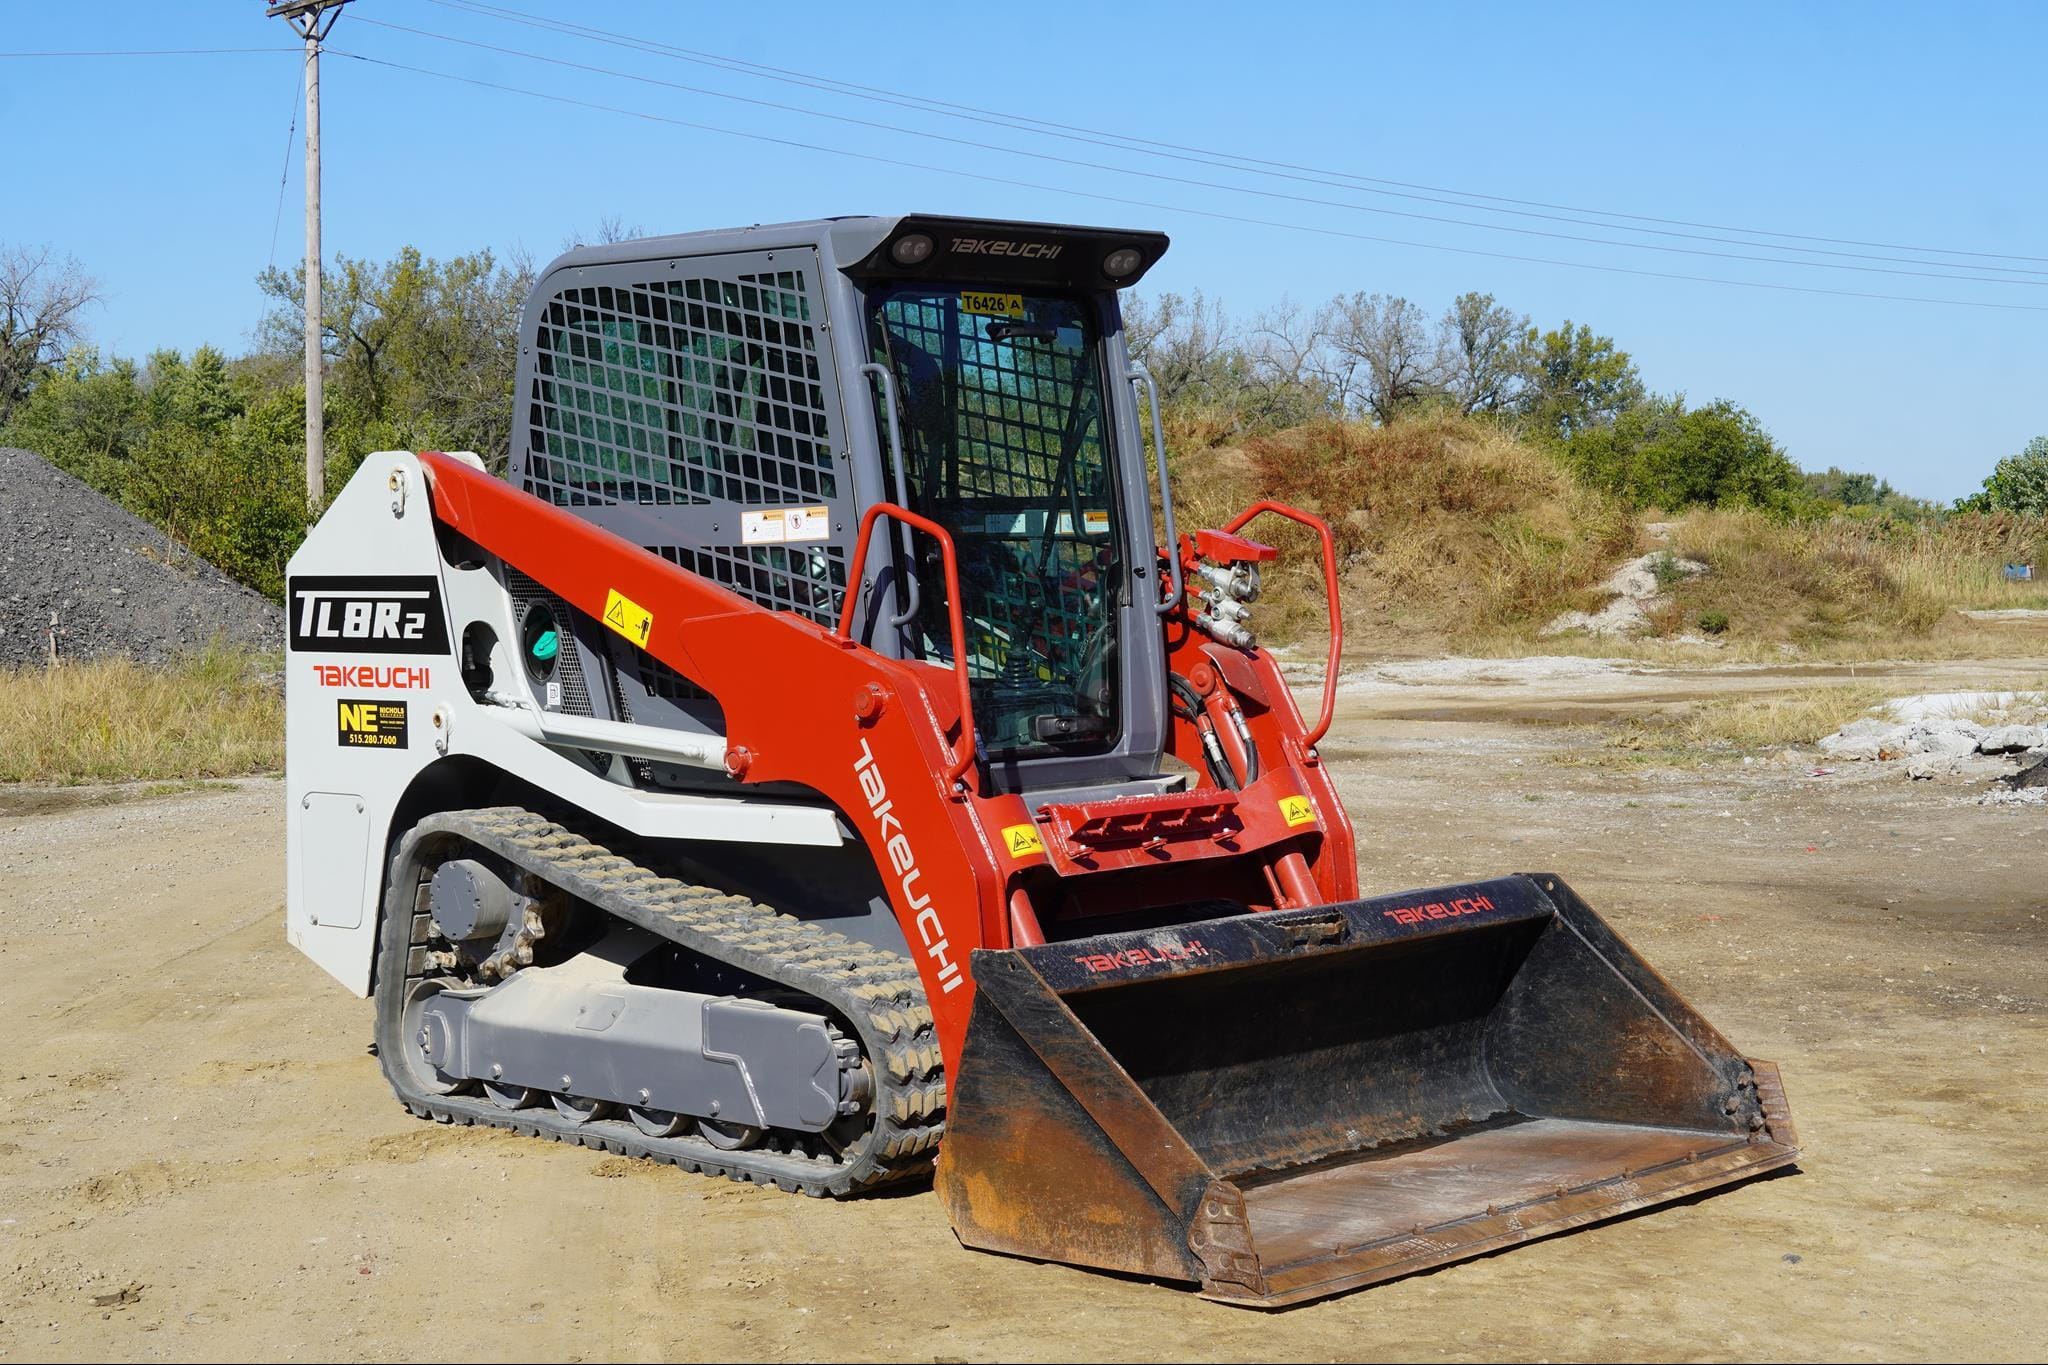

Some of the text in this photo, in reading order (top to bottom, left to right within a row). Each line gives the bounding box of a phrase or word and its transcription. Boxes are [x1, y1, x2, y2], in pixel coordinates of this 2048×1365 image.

[950, 238, 1063, 259] TAKEUCHI
[964, 295, 1020, 312] T6426 A
[295, 590, 430, 639] TL8R2
[313, 665, 430, 689] TAKEUCHI
[340, 703, 378, 732] NE
[379, 706, 405, 715] NICHOLS
[349, 733, 397, 745] 515.280.7600
[853, 737, 964, 994] TAKEUCHI
[1383, 896, 1495, 925] TAKEUCHI
[1074, 940, 1209, 973] TAKEUCHI
